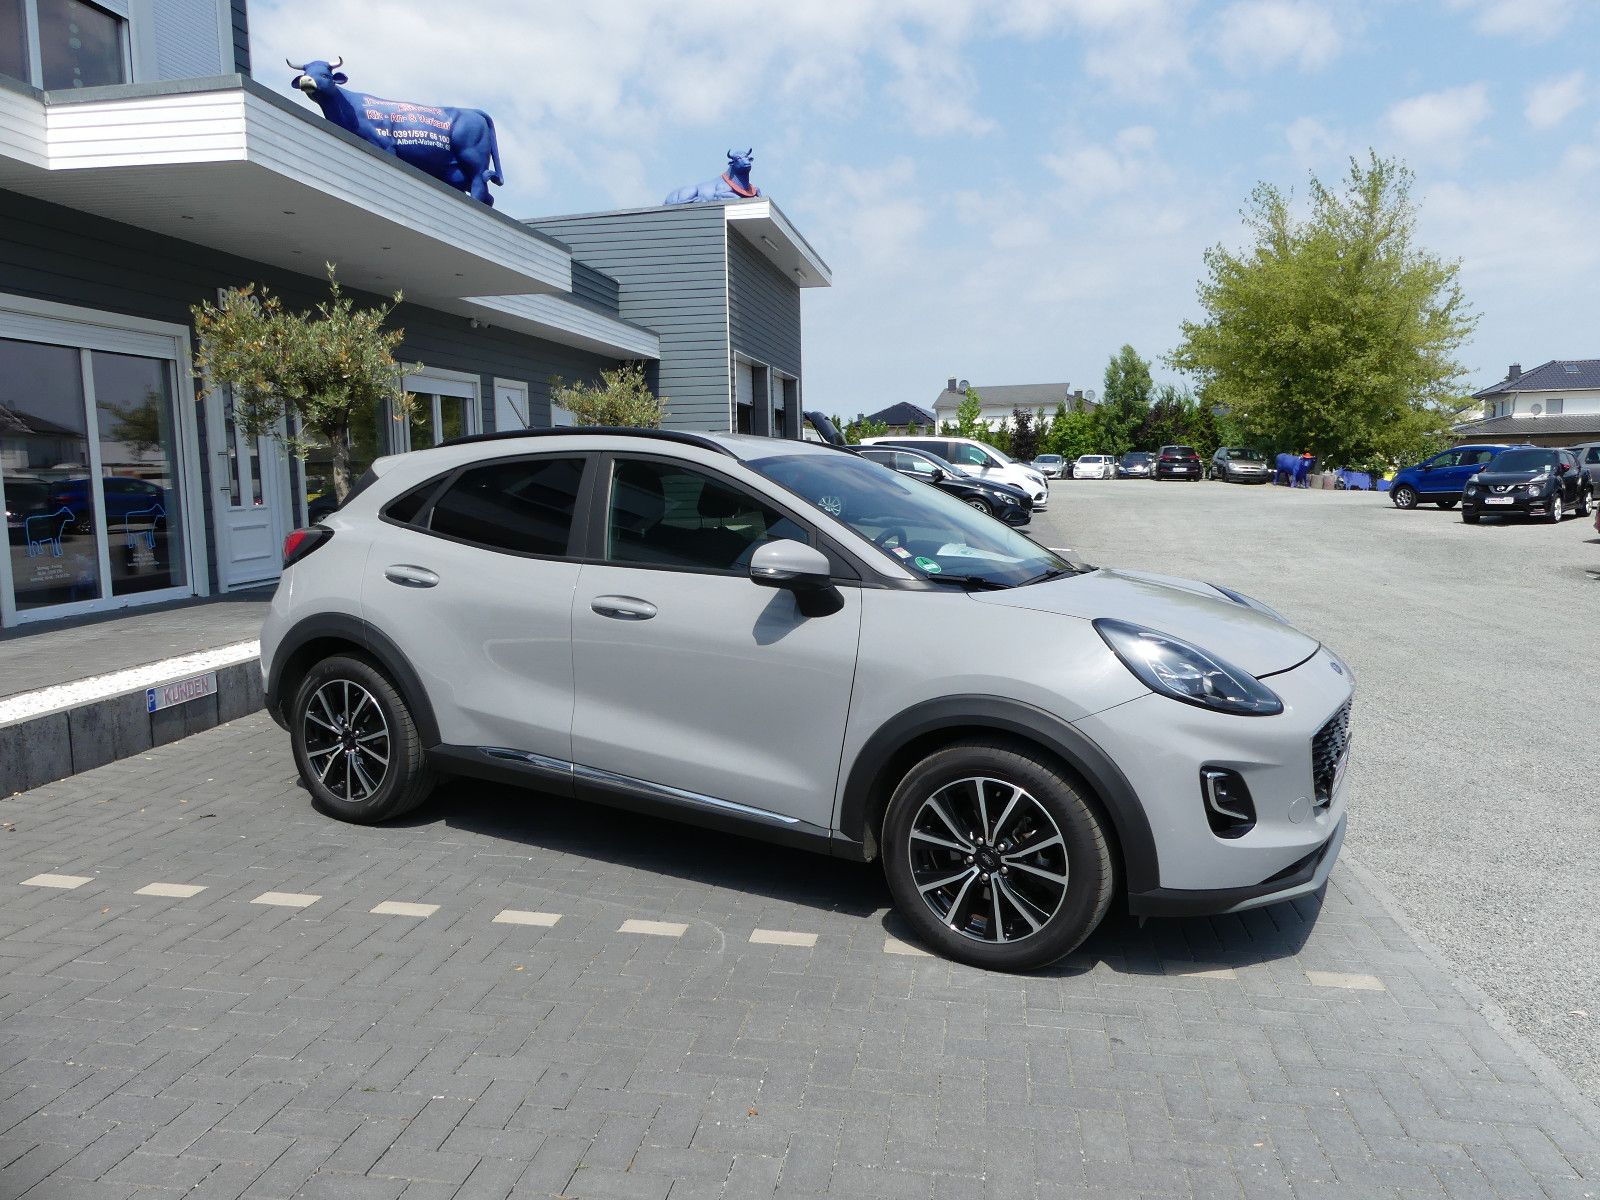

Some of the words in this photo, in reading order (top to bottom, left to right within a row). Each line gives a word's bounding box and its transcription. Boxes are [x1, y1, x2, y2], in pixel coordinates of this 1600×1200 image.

[376, 128, 391, 137] Tel.
[393, 130, 428, 139] 0391/597
[148, 694, 155, 707] P
[163, 676, 209, 705] KUNDEN
